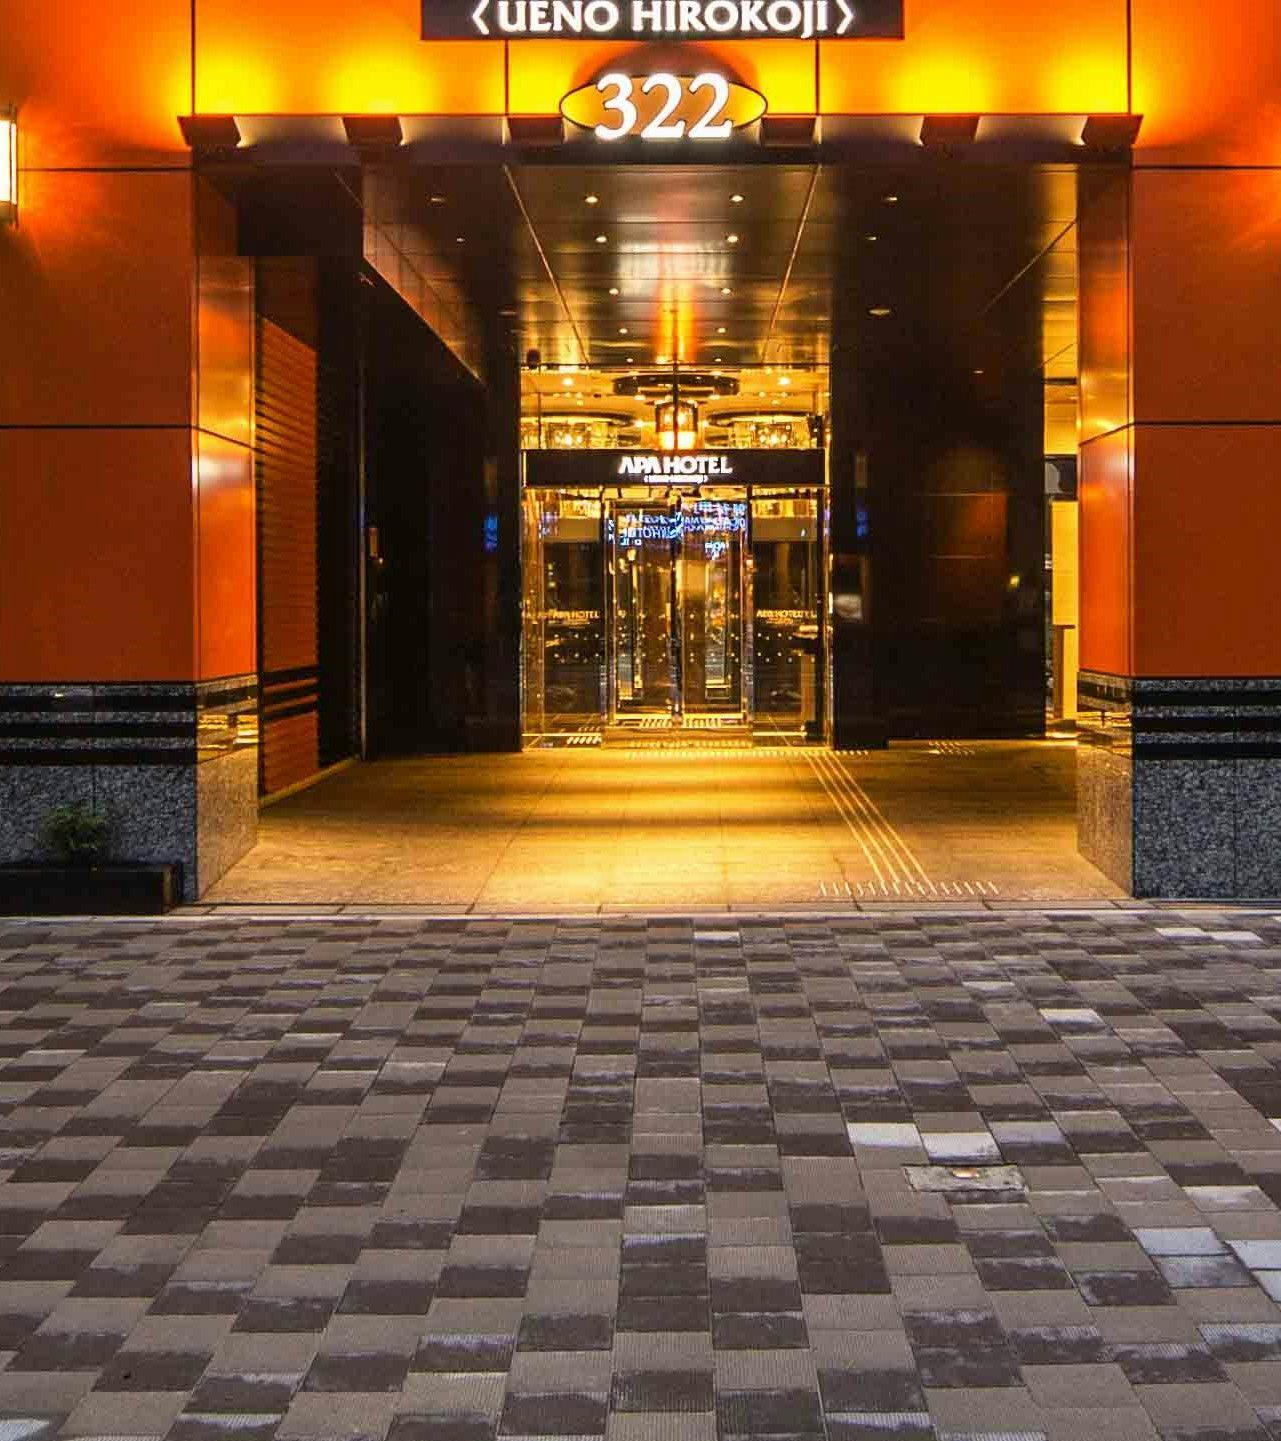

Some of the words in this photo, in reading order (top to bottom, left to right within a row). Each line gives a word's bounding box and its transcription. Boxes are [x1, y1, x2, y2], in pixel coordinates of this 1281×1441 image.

[593, 72, 734, 141] 322
[618, 456, 661, 474] APA
[662, 455, 733, 474] HOTEL
